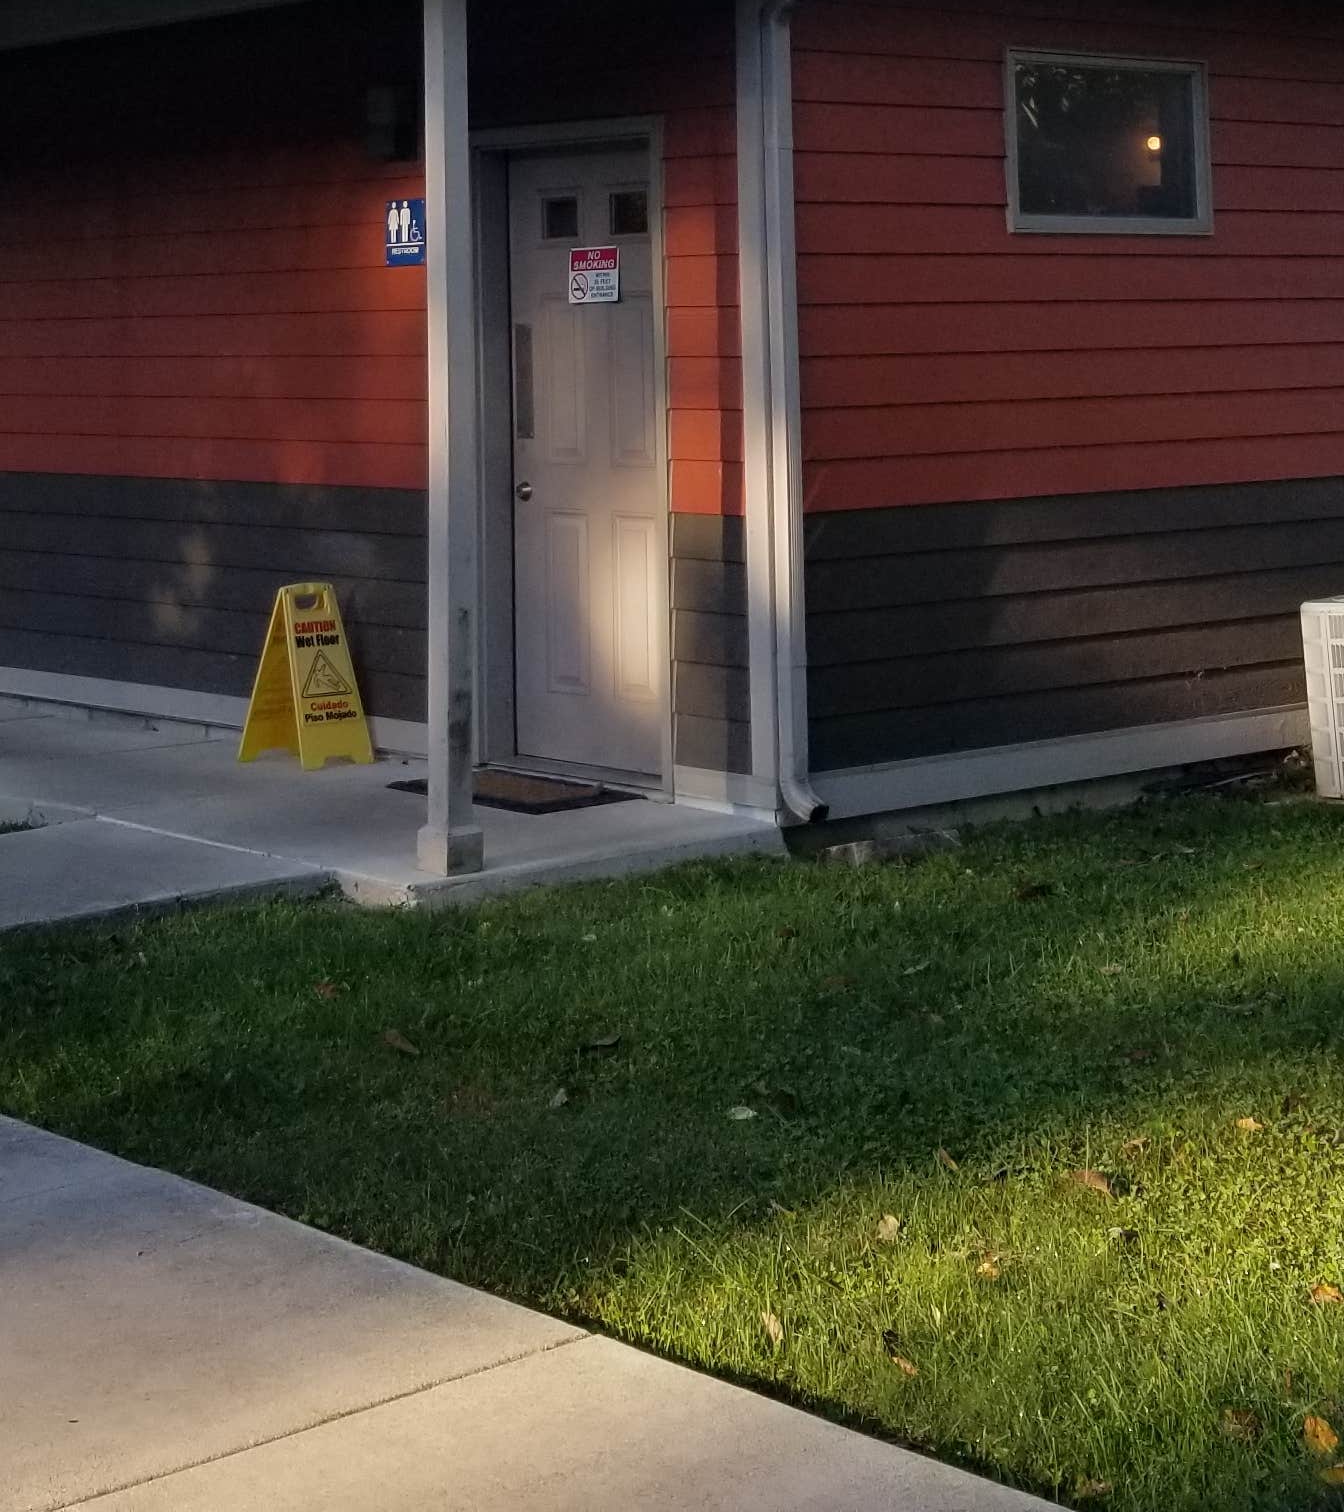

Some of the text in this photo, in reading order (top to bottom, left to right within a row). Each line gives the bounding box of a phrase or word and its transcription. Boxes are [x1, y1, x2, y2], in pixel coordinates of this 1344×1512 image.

[391, 246, 420, 255] RESTROOM
[587, 250, 601, 260] NO
[573, 259, 615, 270] SMOKING
[295, 619, 337, 634] CAUTION
[295, 635, 315, 648] Wet
[316, 633, 340, 647] Floor
[310, 699, 349, 712] Cuidado
[304, 709, 357, 723] Piso Mojado
